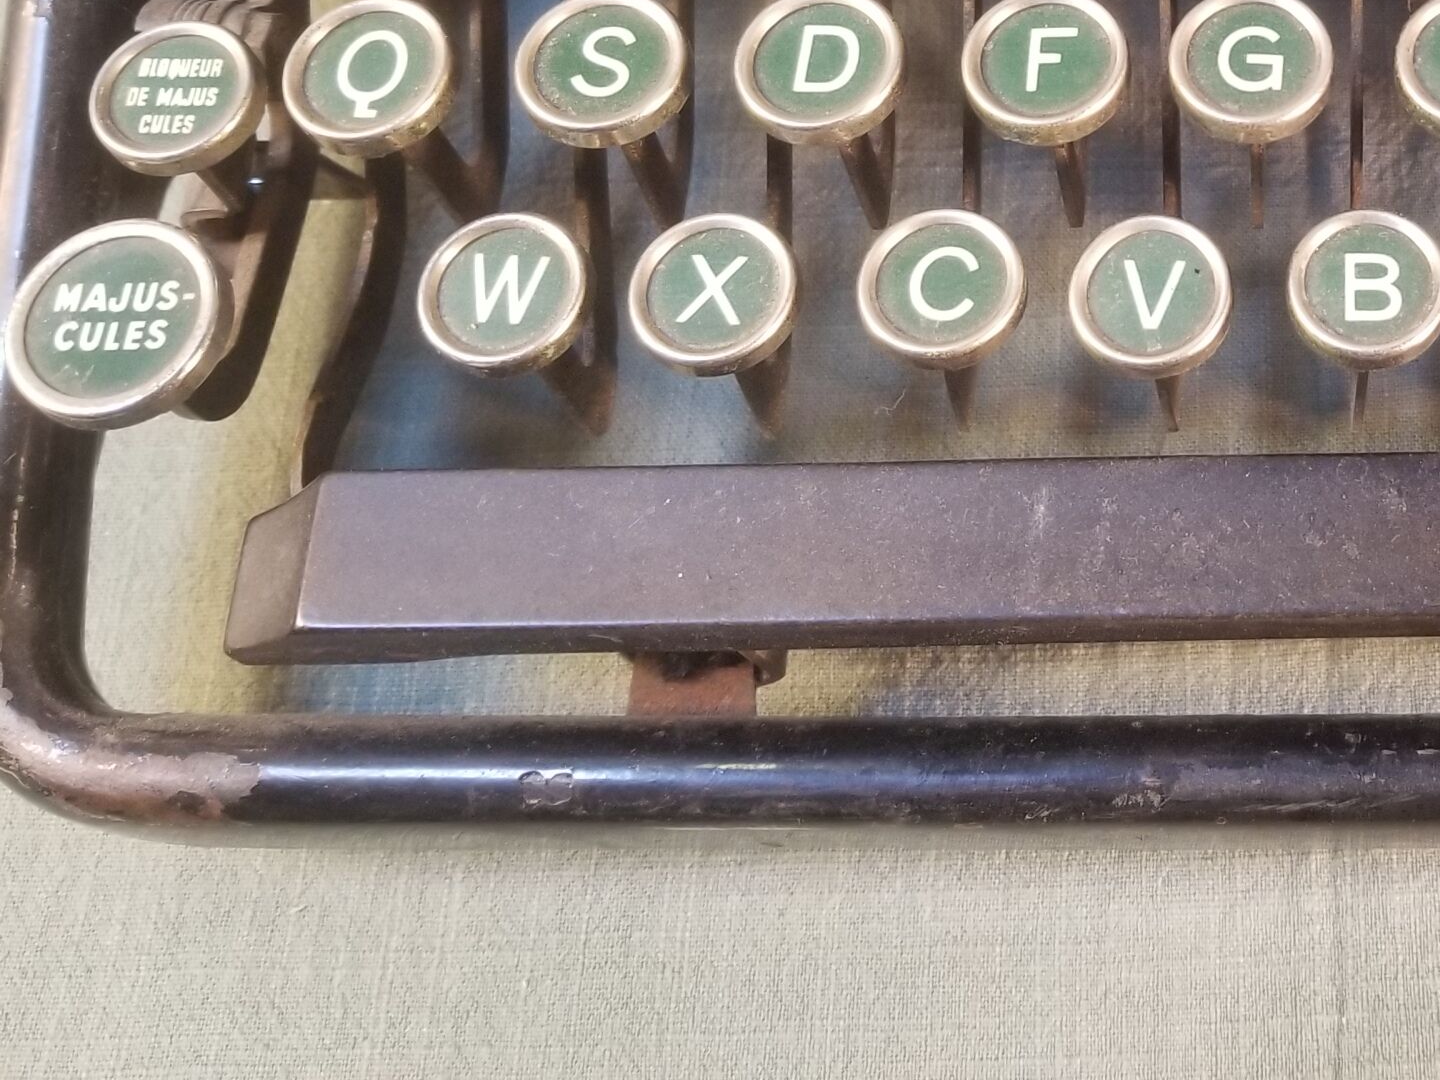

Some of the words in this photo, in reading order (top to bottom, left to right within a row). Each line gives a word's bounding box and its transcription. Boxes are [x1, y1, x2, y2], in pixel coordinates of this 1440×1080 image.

[336, 29, 409, 115] Q
[570, 26, 636, 98] S
[792, 24, 860, 93] D
[1025, 27, 1079, 92] F
[1217, 26, 1284, 92] G
[125, 87, 150, 107] DE
[155, 87, 219, 107] MAJUS
[138, 114, 196, 134] CULES
[53, 280, 196, 313] MAJUS-
[473, 252, 551, 325] W
[675, 254, 748, 326] X
[908, 246, 979, 323] C
[1123, 259, 1186, 330] V
[1344, 253, 1403, 322] B
[53, 319, 169, 352] CULES
